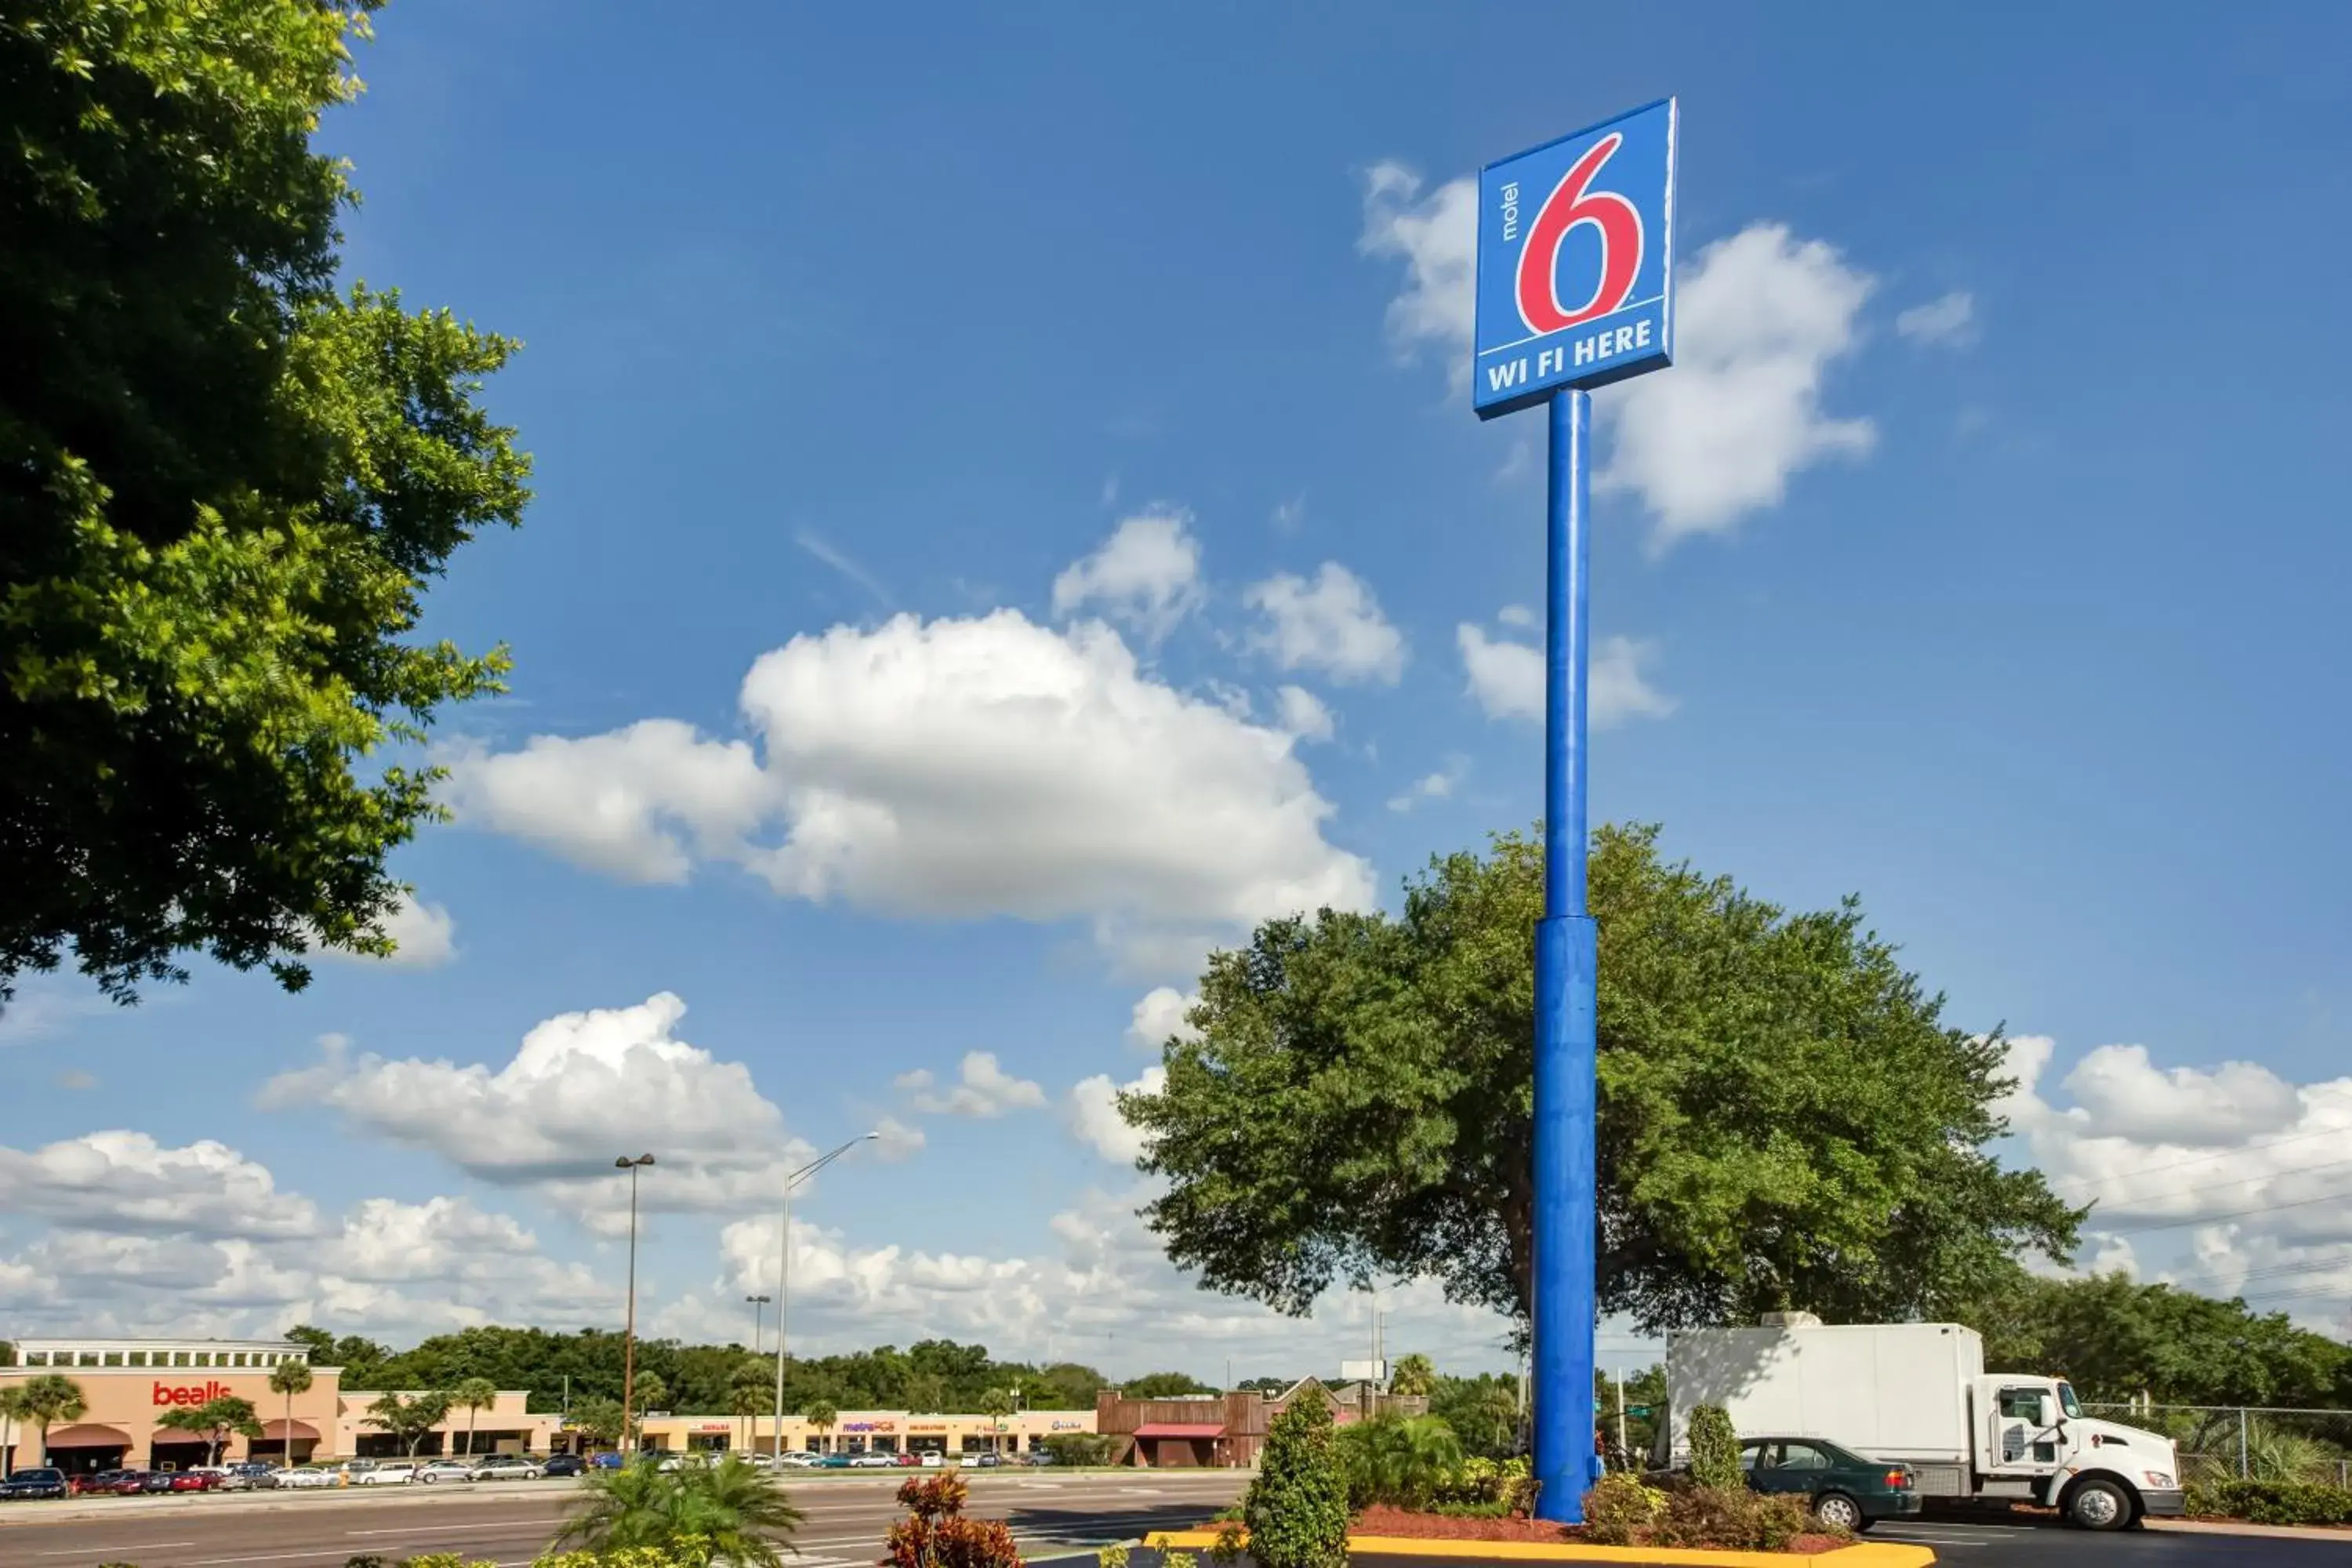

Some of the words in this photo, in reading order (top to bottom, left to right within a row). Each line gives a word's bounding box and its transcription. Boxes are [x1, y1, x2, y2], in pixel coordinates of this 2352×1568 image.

[1500, 181, 1519, 241] motel
[1515, 132, 1645, 337] 6
[1488, 358, 1527, 391] WI
[1538, 347, 1563, 377] FI
[1574, 319, 1651, 366] HERE
[153, 1381, 232, 1406] bealls
